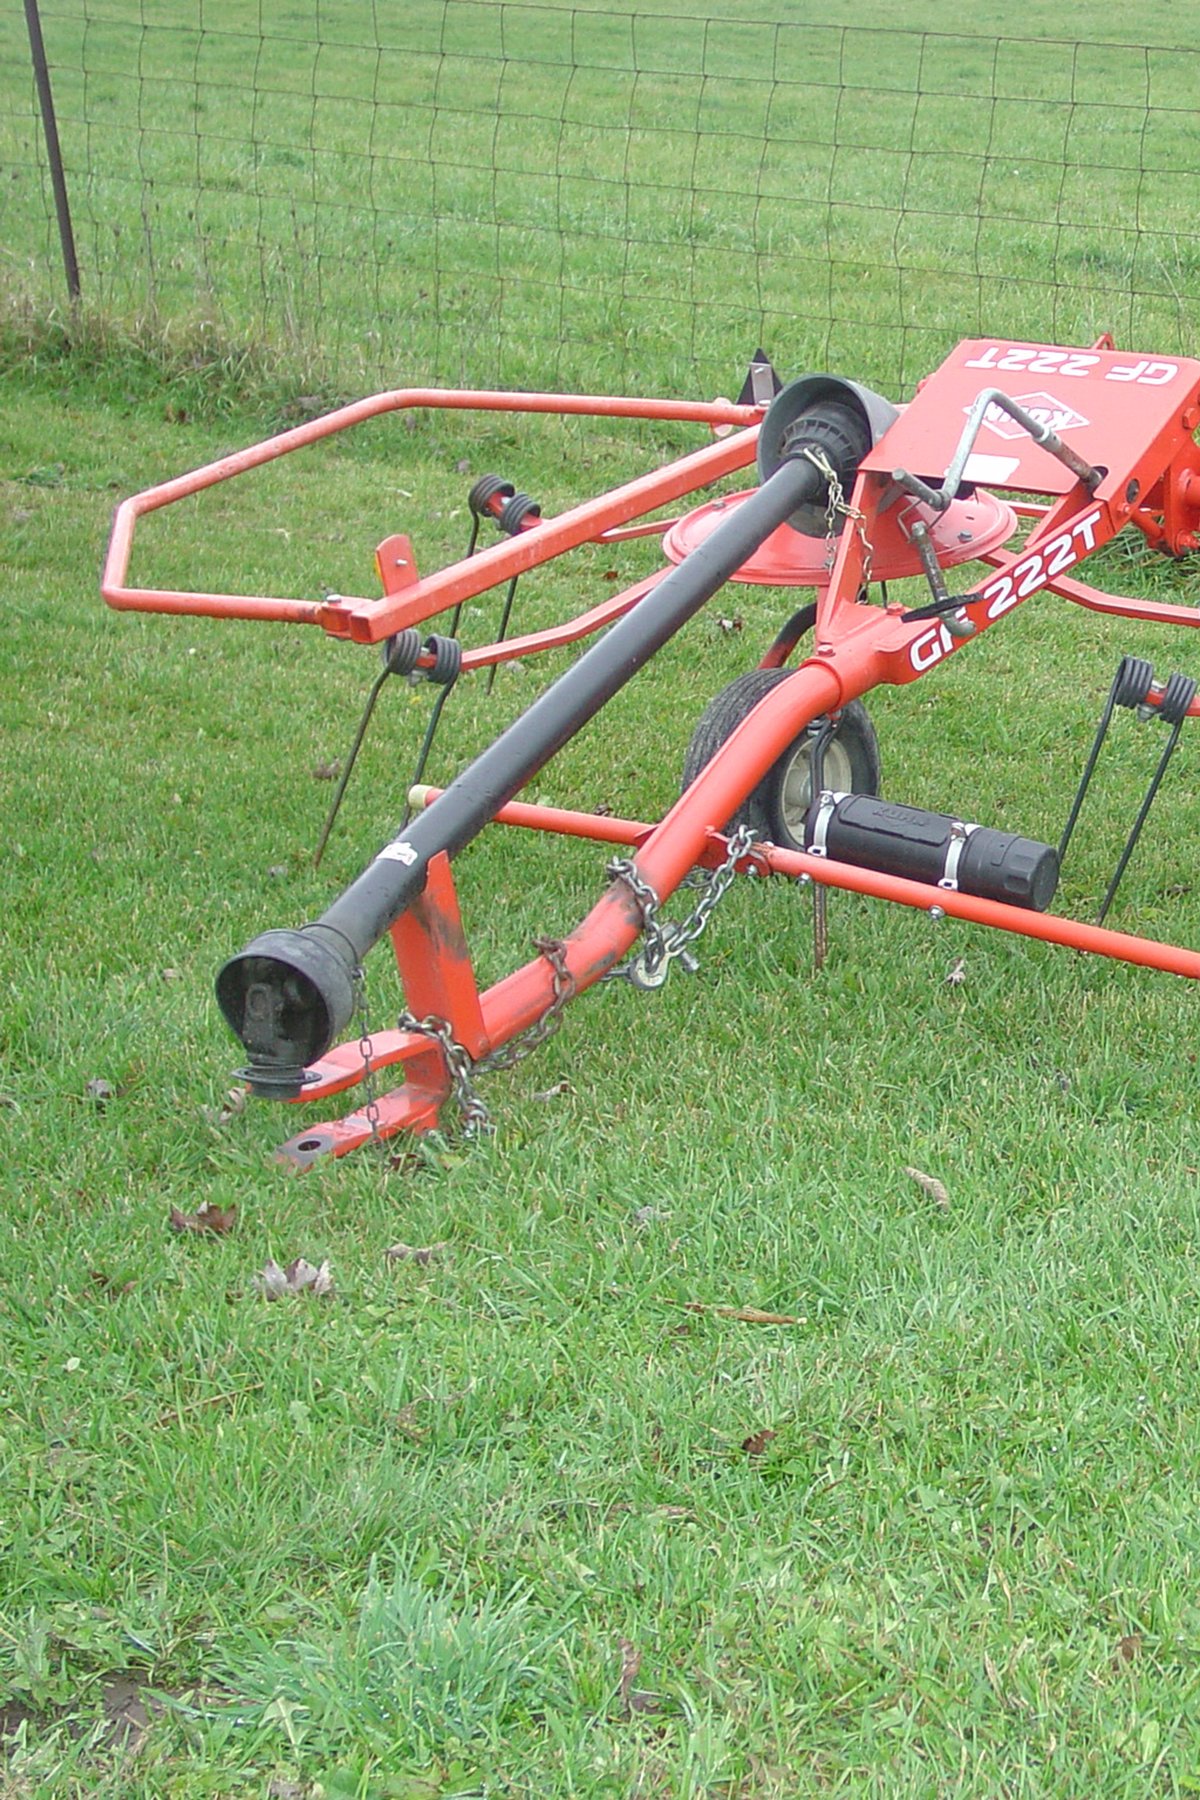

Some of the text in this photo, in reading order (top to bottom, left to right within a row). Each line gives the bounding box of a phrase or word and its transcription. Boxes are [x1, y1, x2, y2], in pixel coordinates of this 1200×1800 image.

[964, 346, 1179, 386] GF 222T
[984, 511, 1100, 619] 222T
